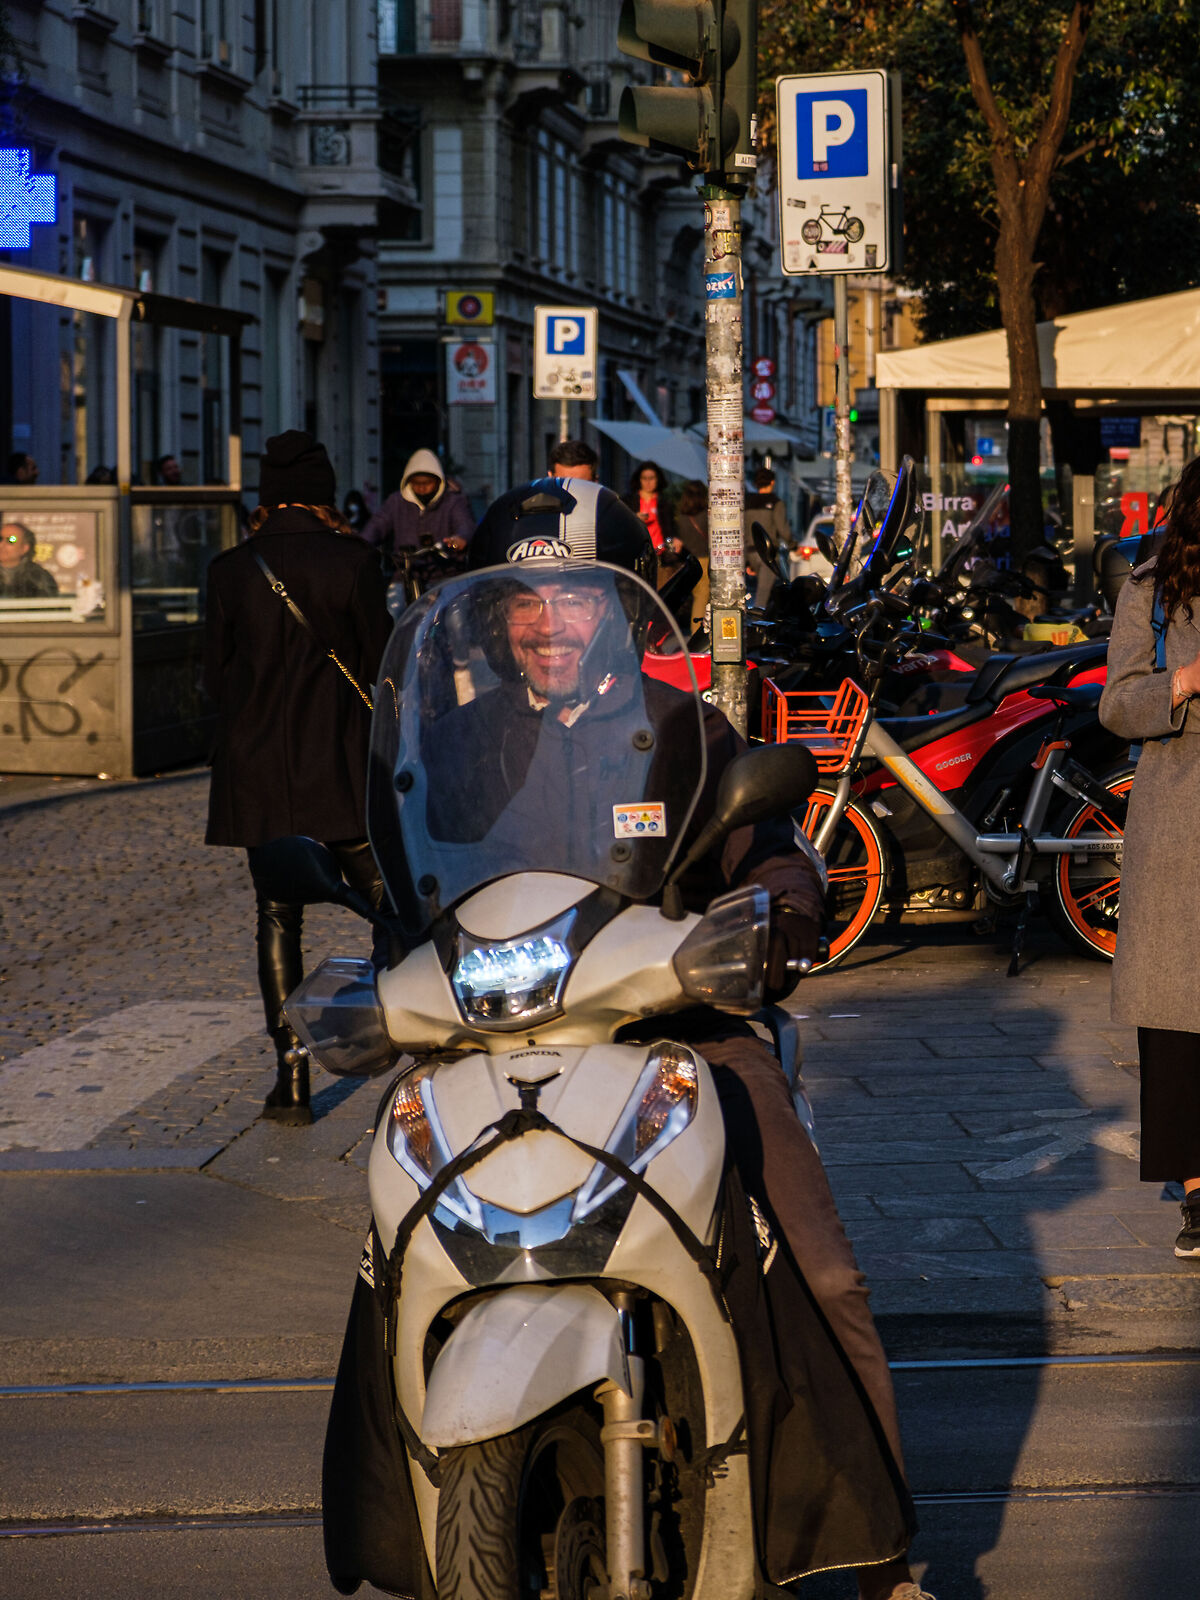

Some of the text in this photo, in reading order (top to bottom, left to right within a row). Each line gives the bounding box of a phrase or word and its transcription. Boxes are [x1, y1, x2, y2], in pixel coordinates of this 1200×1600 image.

[812, 99, 856, 163] P
[553, 318, 580, 352] P
[922, 493, 974, 511] Birra
[511, 540, 569, 561] Airoh
[935, 752, 973, 771] QOODER
[509, 1051, 562, 1060] HONDA
